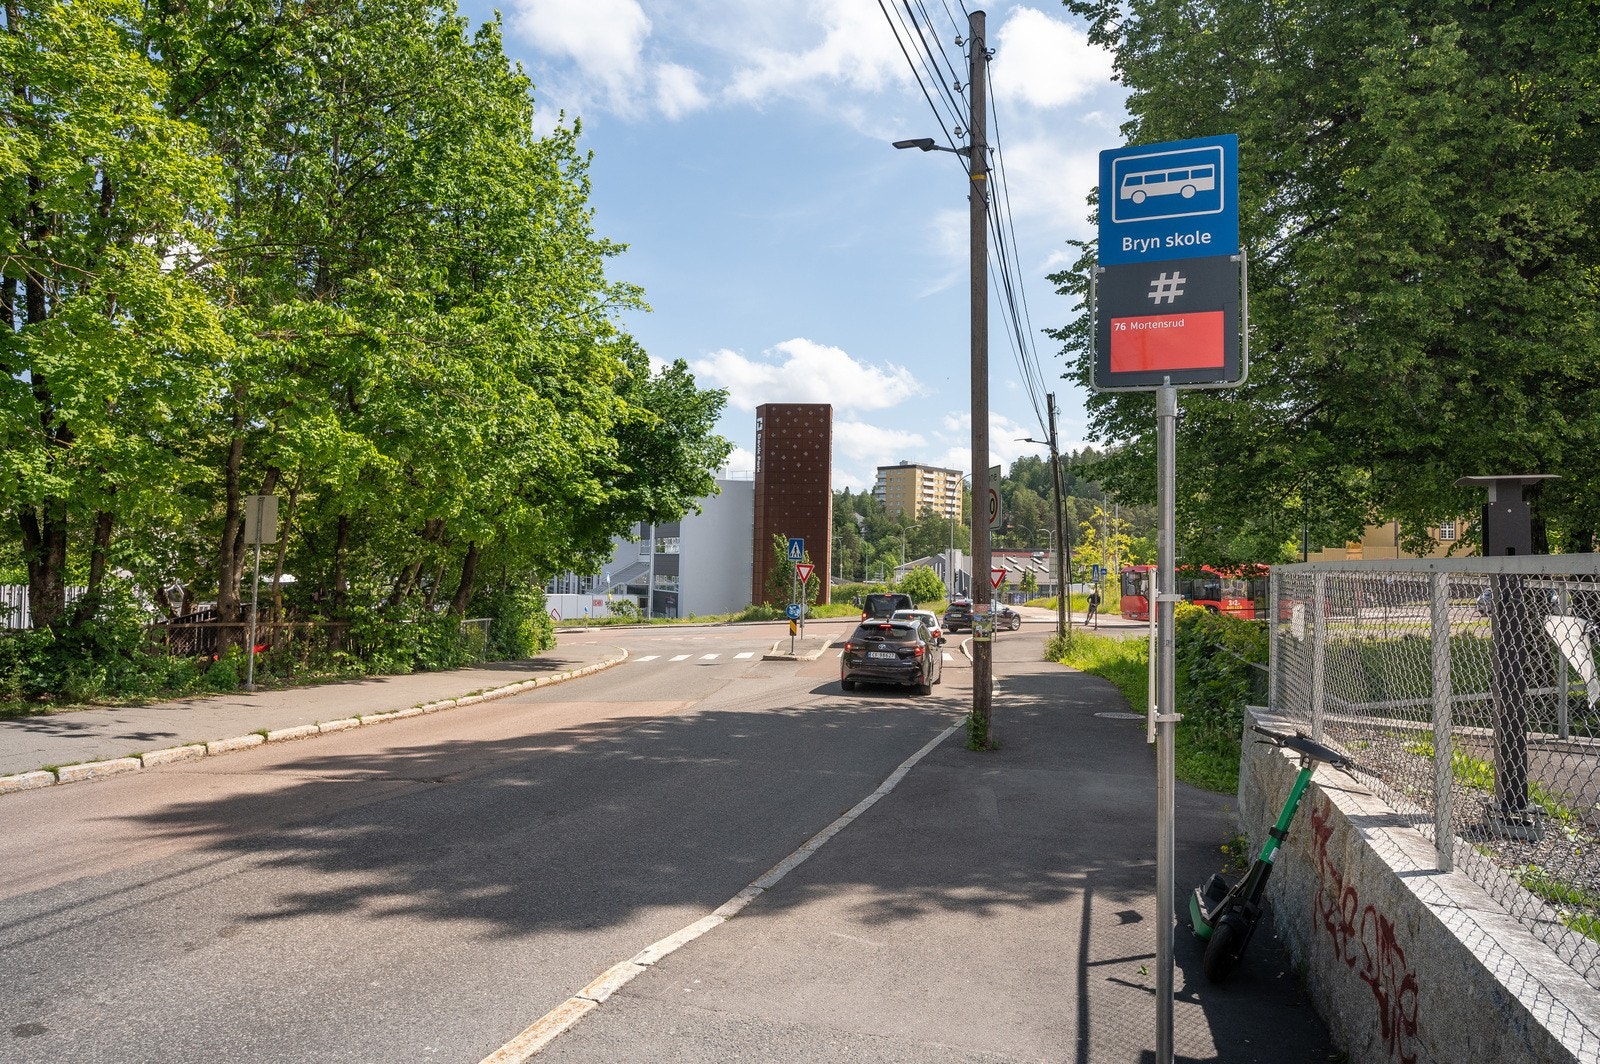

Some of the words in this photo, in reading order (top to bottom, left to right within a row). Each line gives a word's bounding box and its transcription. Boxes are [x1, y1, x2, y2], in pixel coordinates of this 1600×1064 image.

[1122, 236, 1160, 253] Bryn
[1165, 230, 1212, 248] skole
[1114, 322, 1127, 331] 76
[1130, 318, 1185, 330] Mortensrud
